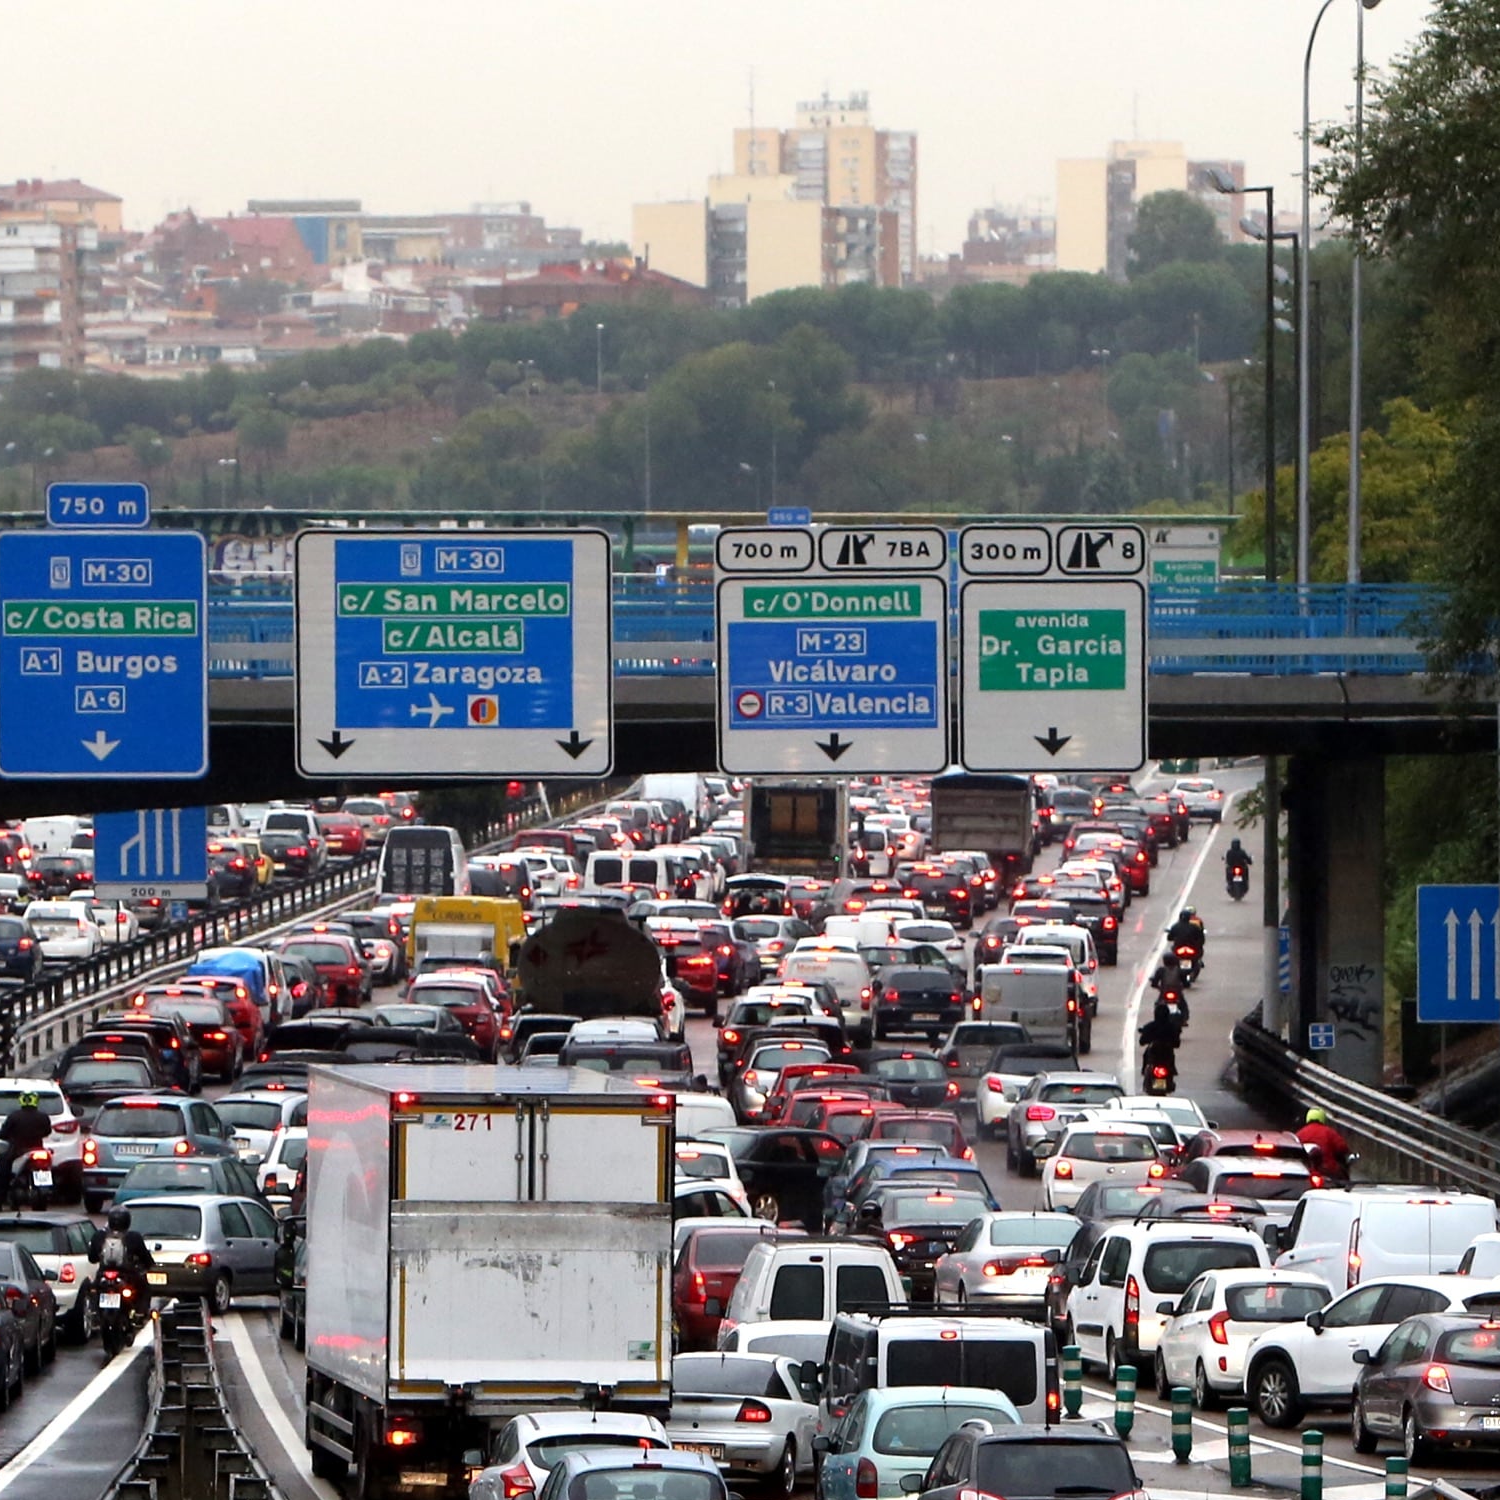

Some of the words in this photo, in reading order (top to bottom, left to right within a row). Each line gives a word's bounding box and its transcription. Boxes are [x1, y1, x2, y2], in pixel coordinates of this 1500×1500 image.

[59, 497, 104, 515] 750
[118, 500, 137, 515] m
[732, 543, 768, 558] 700
[779, 546, 797, 558] m
[971, 543, 1016, 560] 300
[1023, 547, 1042, 560] m
[1122, 542, 1135, 559] 8
[440, 551, 499, 569] M-30
[87, 564, 147, 582] M-30
[383, 589, 437, 612] San
[450, 589, 564, 612] Marcelo
[135, 607, 192, 629] Rica
[1015, 613, 1089, 628] avenida
[802, 633, 861, 651] M-23
[982, 635, 1018, 656] Dr.
[1036, 633, 1122, 656] García
[26, 653, 57, 670] A-1
[77, 651, 177, 679] Burgos
[769, 659, 896, 682] Vicálvaro
[365, 667, 403, 685] A-2
[413, 662, 543, 690] Zaragoza
[1016, 663, 1088, 687] Tapia
[81, 691, 120, 708] A-6
[771, 695, 808, 713] R-3
[815, 691, 930, 714] Valencia
[131, 887, 156, 897] 200
[161, 889, 172, 897] m
[454, 1113, 492, 1131] 271
